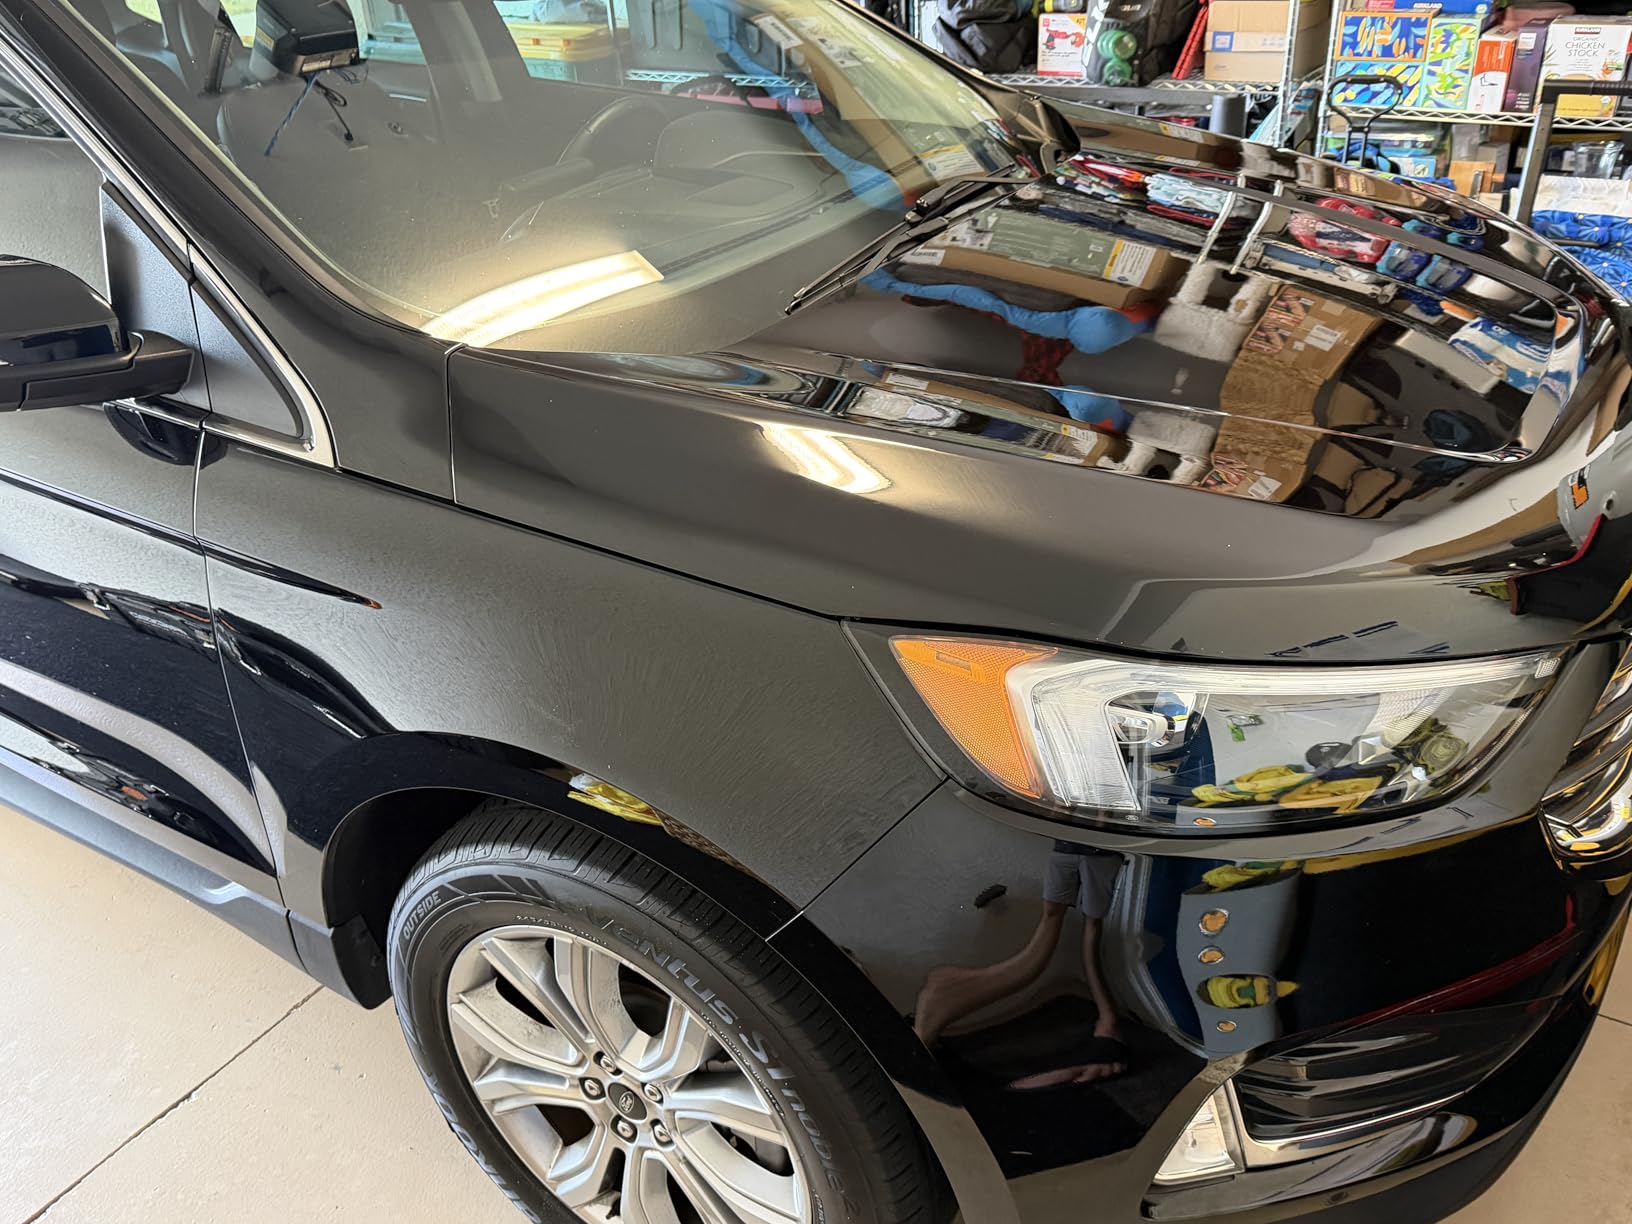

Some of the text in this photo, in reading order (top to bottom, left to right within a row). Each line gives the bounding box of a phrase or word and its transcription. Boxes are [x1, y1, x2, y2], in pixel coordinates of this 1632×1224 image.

[1565, 41, 1605, 49] CHICKEN
[1568, 49, 1599, 57] STOCK
[402, 890, 442, 940] OUTSIDE
